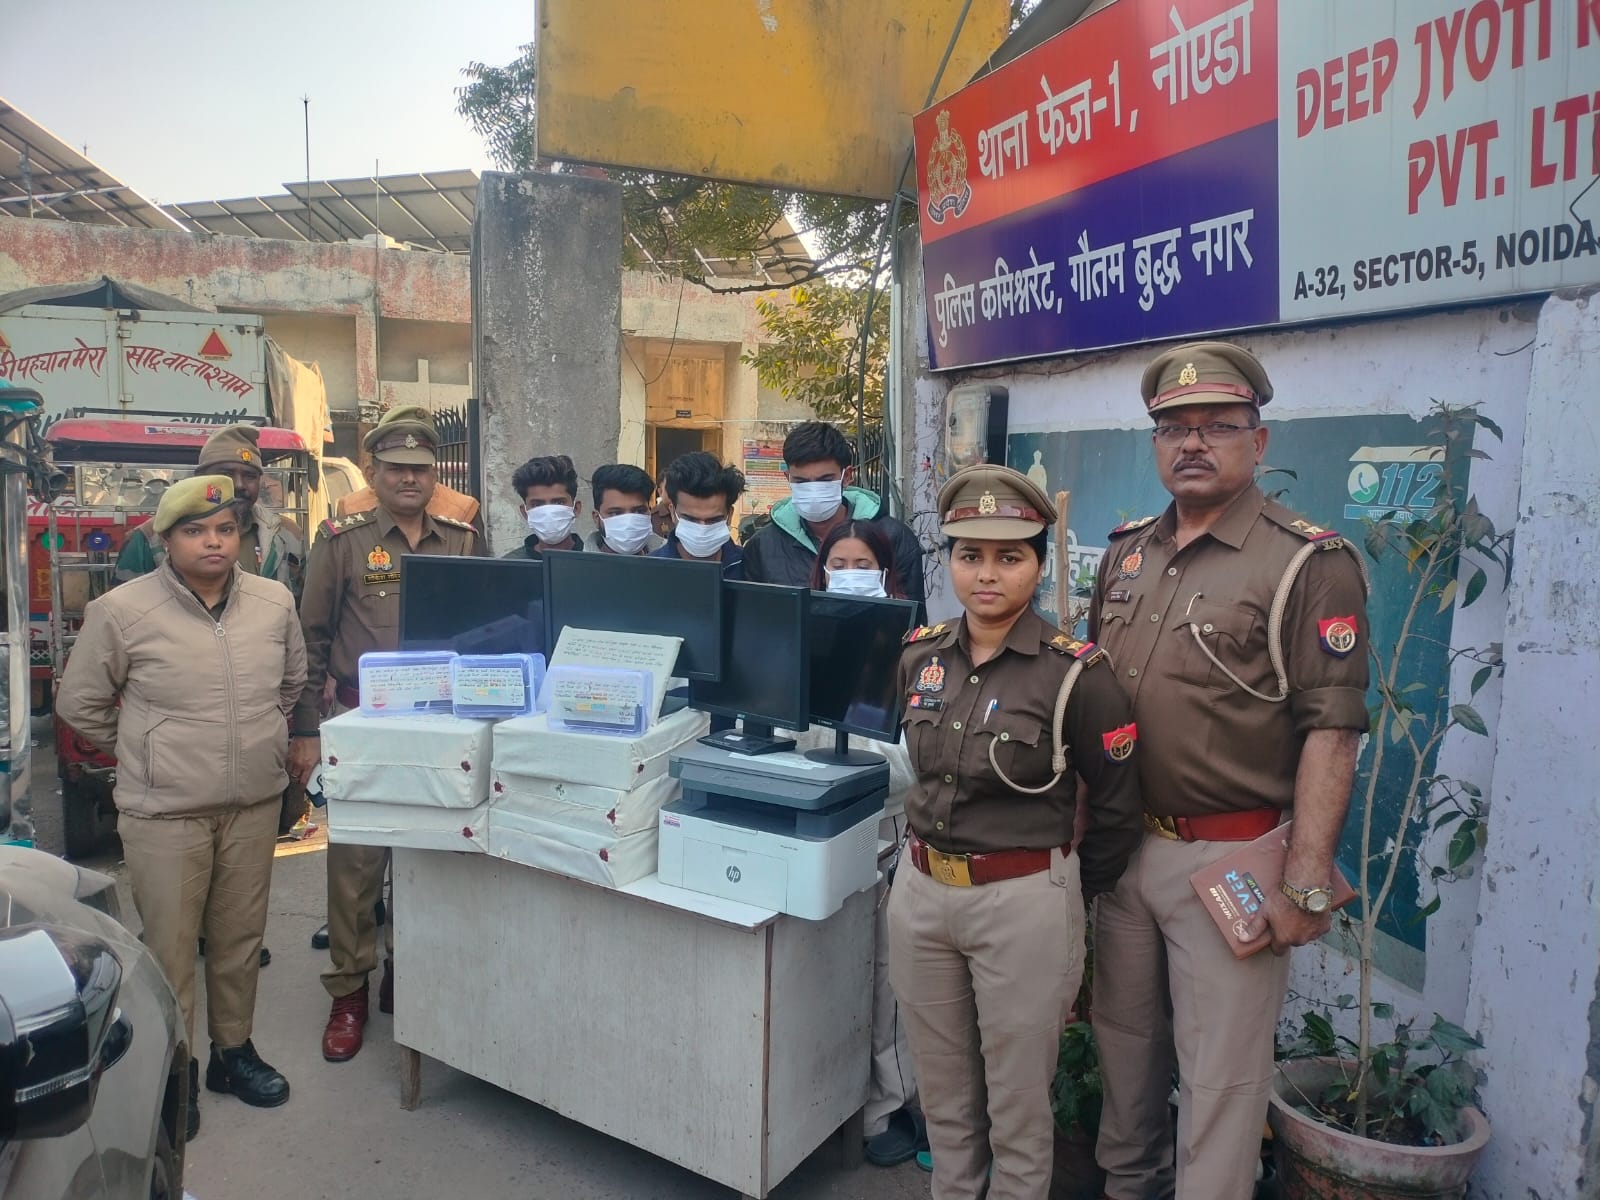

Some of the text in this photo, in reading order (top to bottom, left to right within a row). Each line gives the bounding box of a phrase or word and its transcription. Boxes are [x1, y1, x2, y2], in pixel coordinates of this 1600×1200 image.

[977, 2, 1254, 181] थाना फेज-1, नोएडा
[1296, 37, 1399, 139] DEEP
[1413, 0, 1552, 120] JYOTI
[1407, 119, 1505, 215] PVT.
[934, 273, 976, 348] पुलिस
[1068, 229, 1126, 302] गौतम
[1133, 228, 1182, 312] बुद्ध
[1190, 208, 1254, 276] नगर
[1294, 219, 1600, 301] A-32, SECTOR-5, NOIDA
[18, 350, 73, 383] पहचान
[1377, 463, 1444, 507] 112
[728, 865, 741, 883] hp
[1225, 870, 1258, 914] EVER
